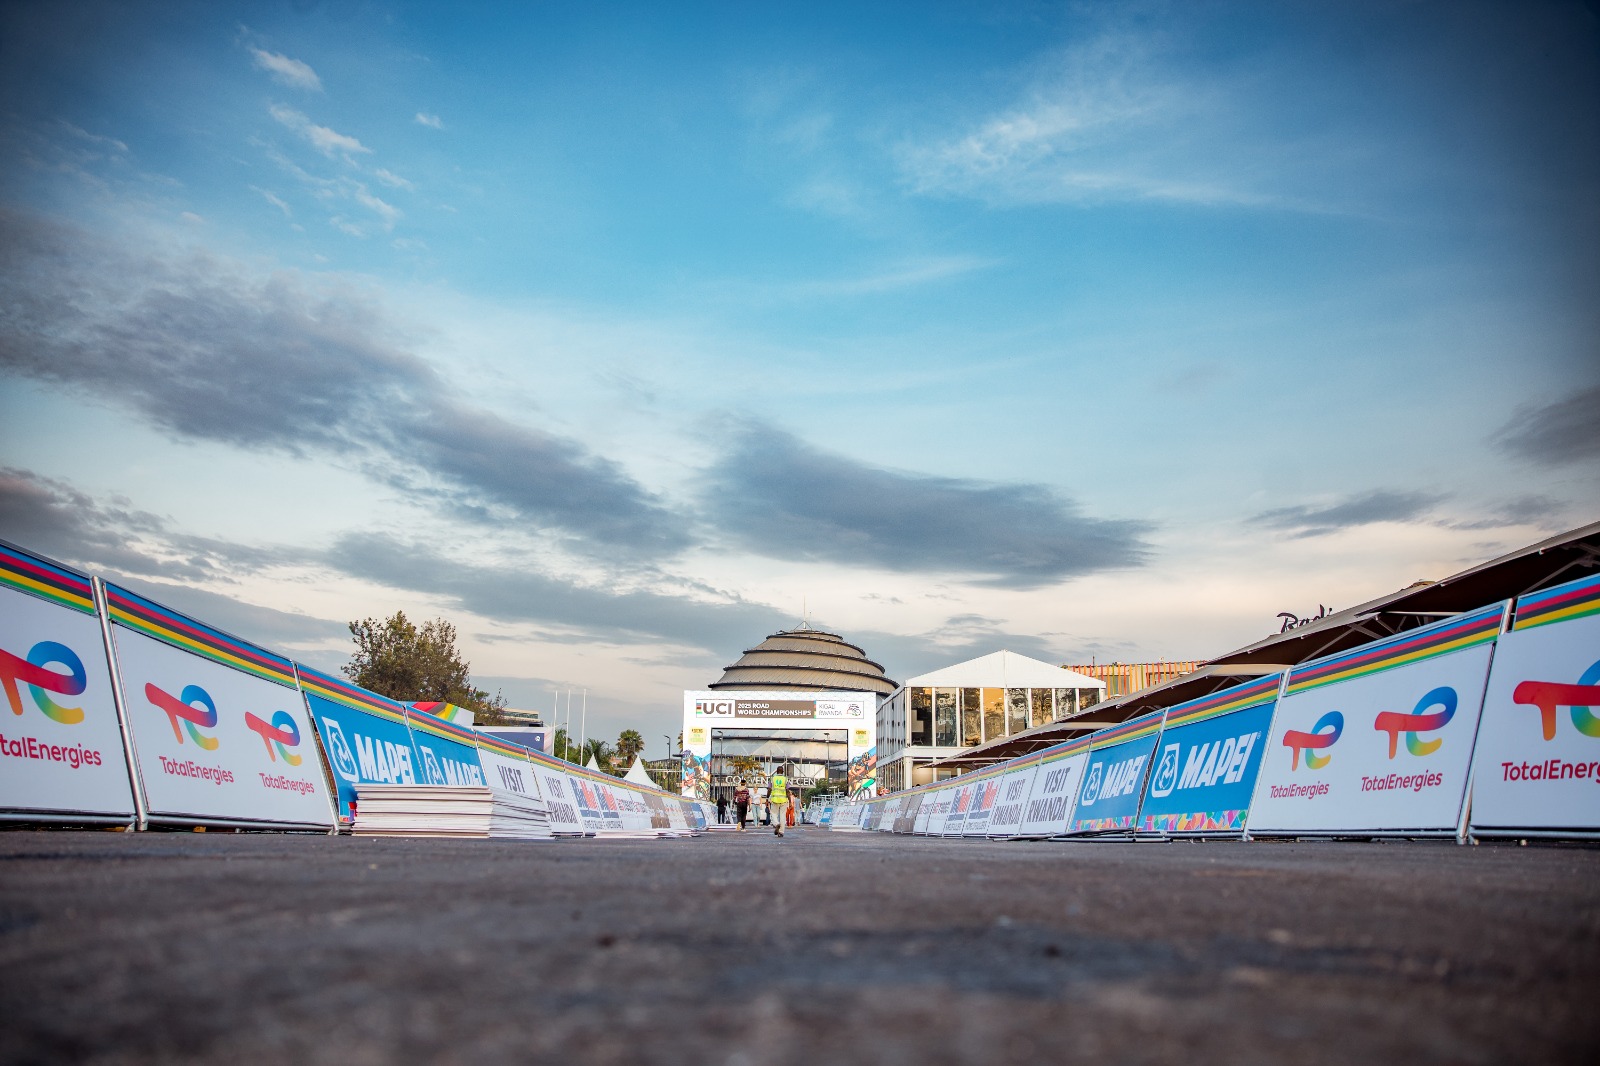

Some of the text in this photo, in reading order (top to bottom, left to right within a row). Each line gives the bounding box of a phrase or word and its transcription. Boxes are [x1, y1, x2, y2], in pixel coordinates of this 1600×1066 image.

[703, 702, 732, 714] UCI
[0, 733, 102, 769] talEnergies
[354, 733, 416, 785] MAPEI
[1177, 731, 1257, 790] MAPEI
[159, 756, 234, 785] TotalEnergies
[497, 764, 525, 793] VISIT
[1044, 767, 1071, 794] VISIT
[1098, 754, 1146, 800] MAPEI
[1361, 769, 1443, 792] TotalEnergies
[1501, 759, 1600, 784] TotalEner
[259, 772, 315, 795] TotalEnergies
[544, 776, 566, 799] VISIT
[1006, 779, 1026, 801] VISIT
[1270, 781, 1329, 800] TotalEnergies
[992, 803, 1022, 826] RWANDA
[1027, 796, 1068, 822] RWANDA
